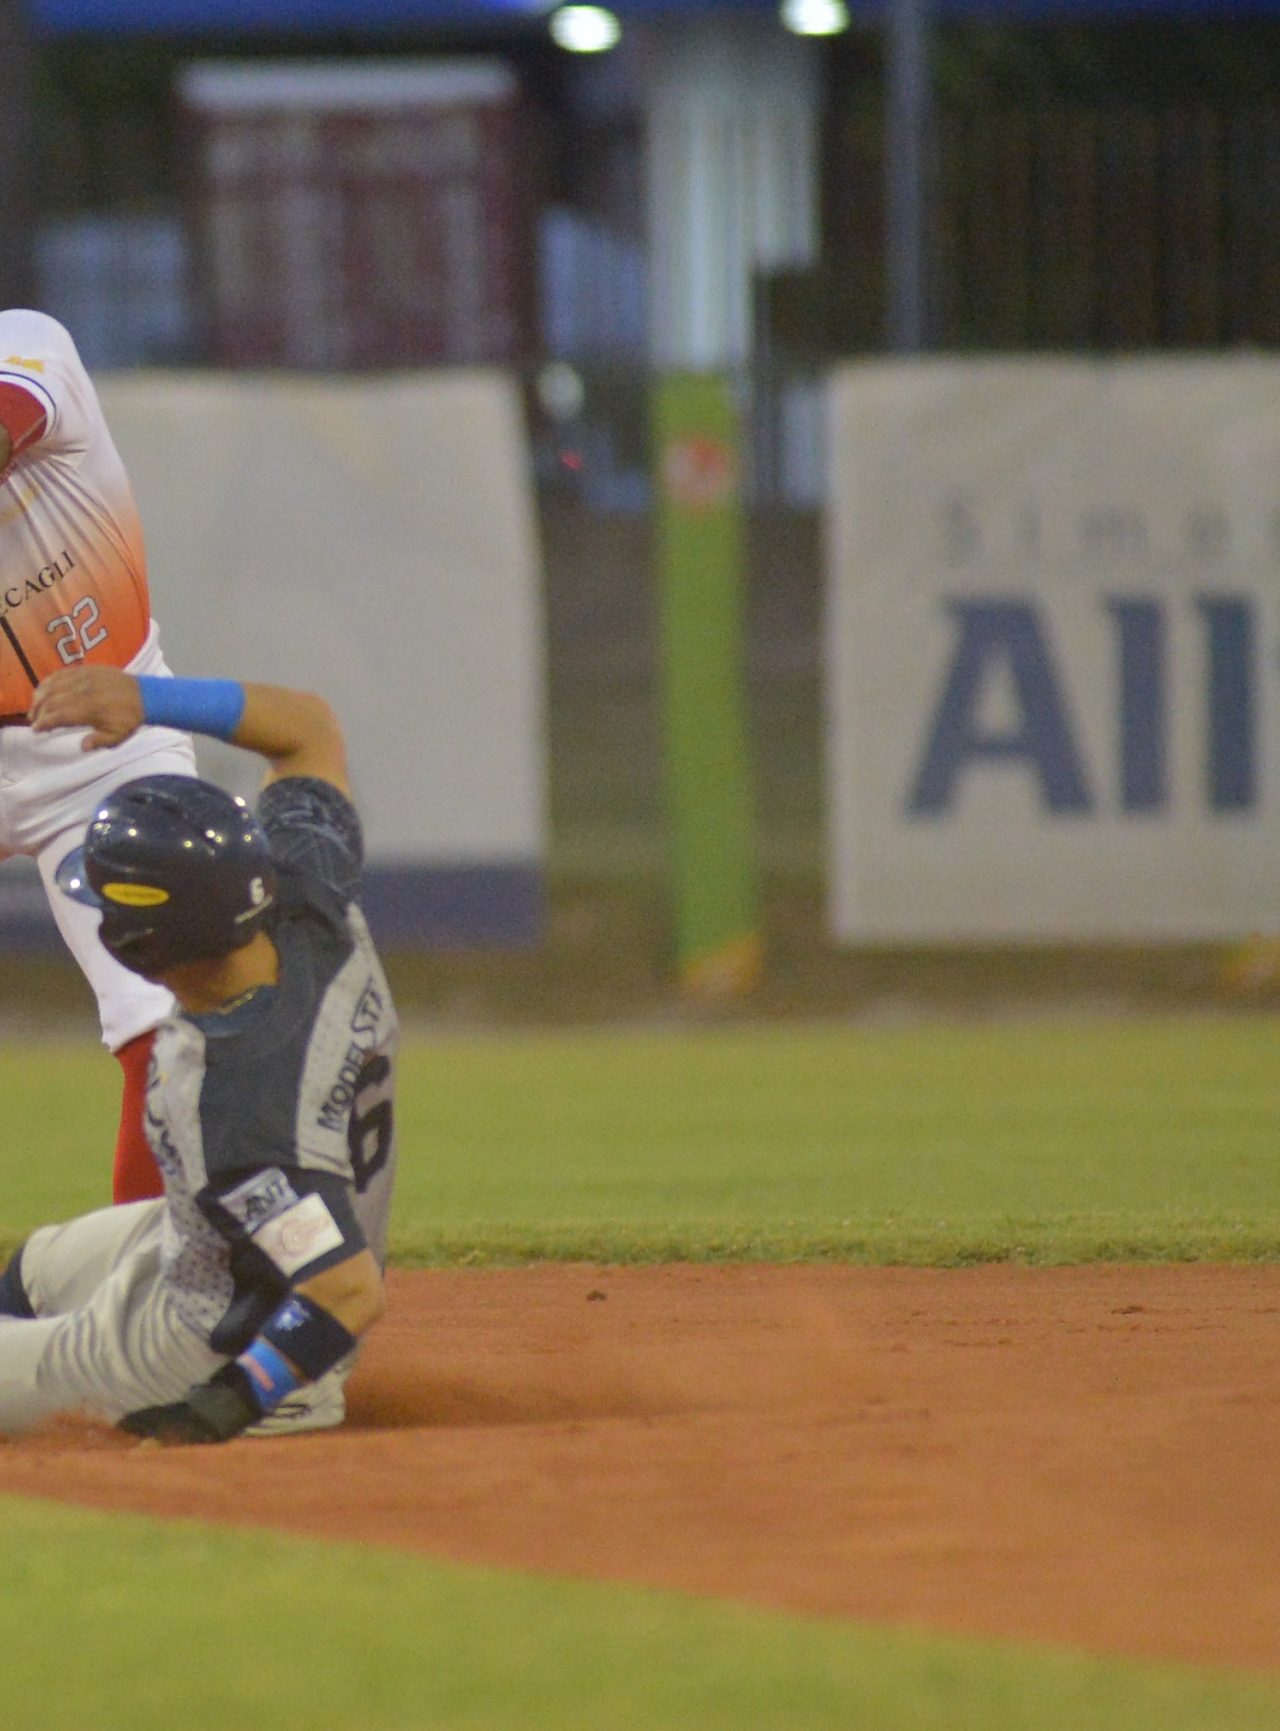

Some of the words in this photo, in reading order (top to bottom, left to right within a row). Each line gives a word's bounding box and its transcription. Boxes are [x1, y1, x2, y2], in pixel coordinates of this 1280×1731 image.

[46, 595, 108, 666] 22
[250, 876, 266, 905] 6
[348, 1054, 394, 1194] 6
